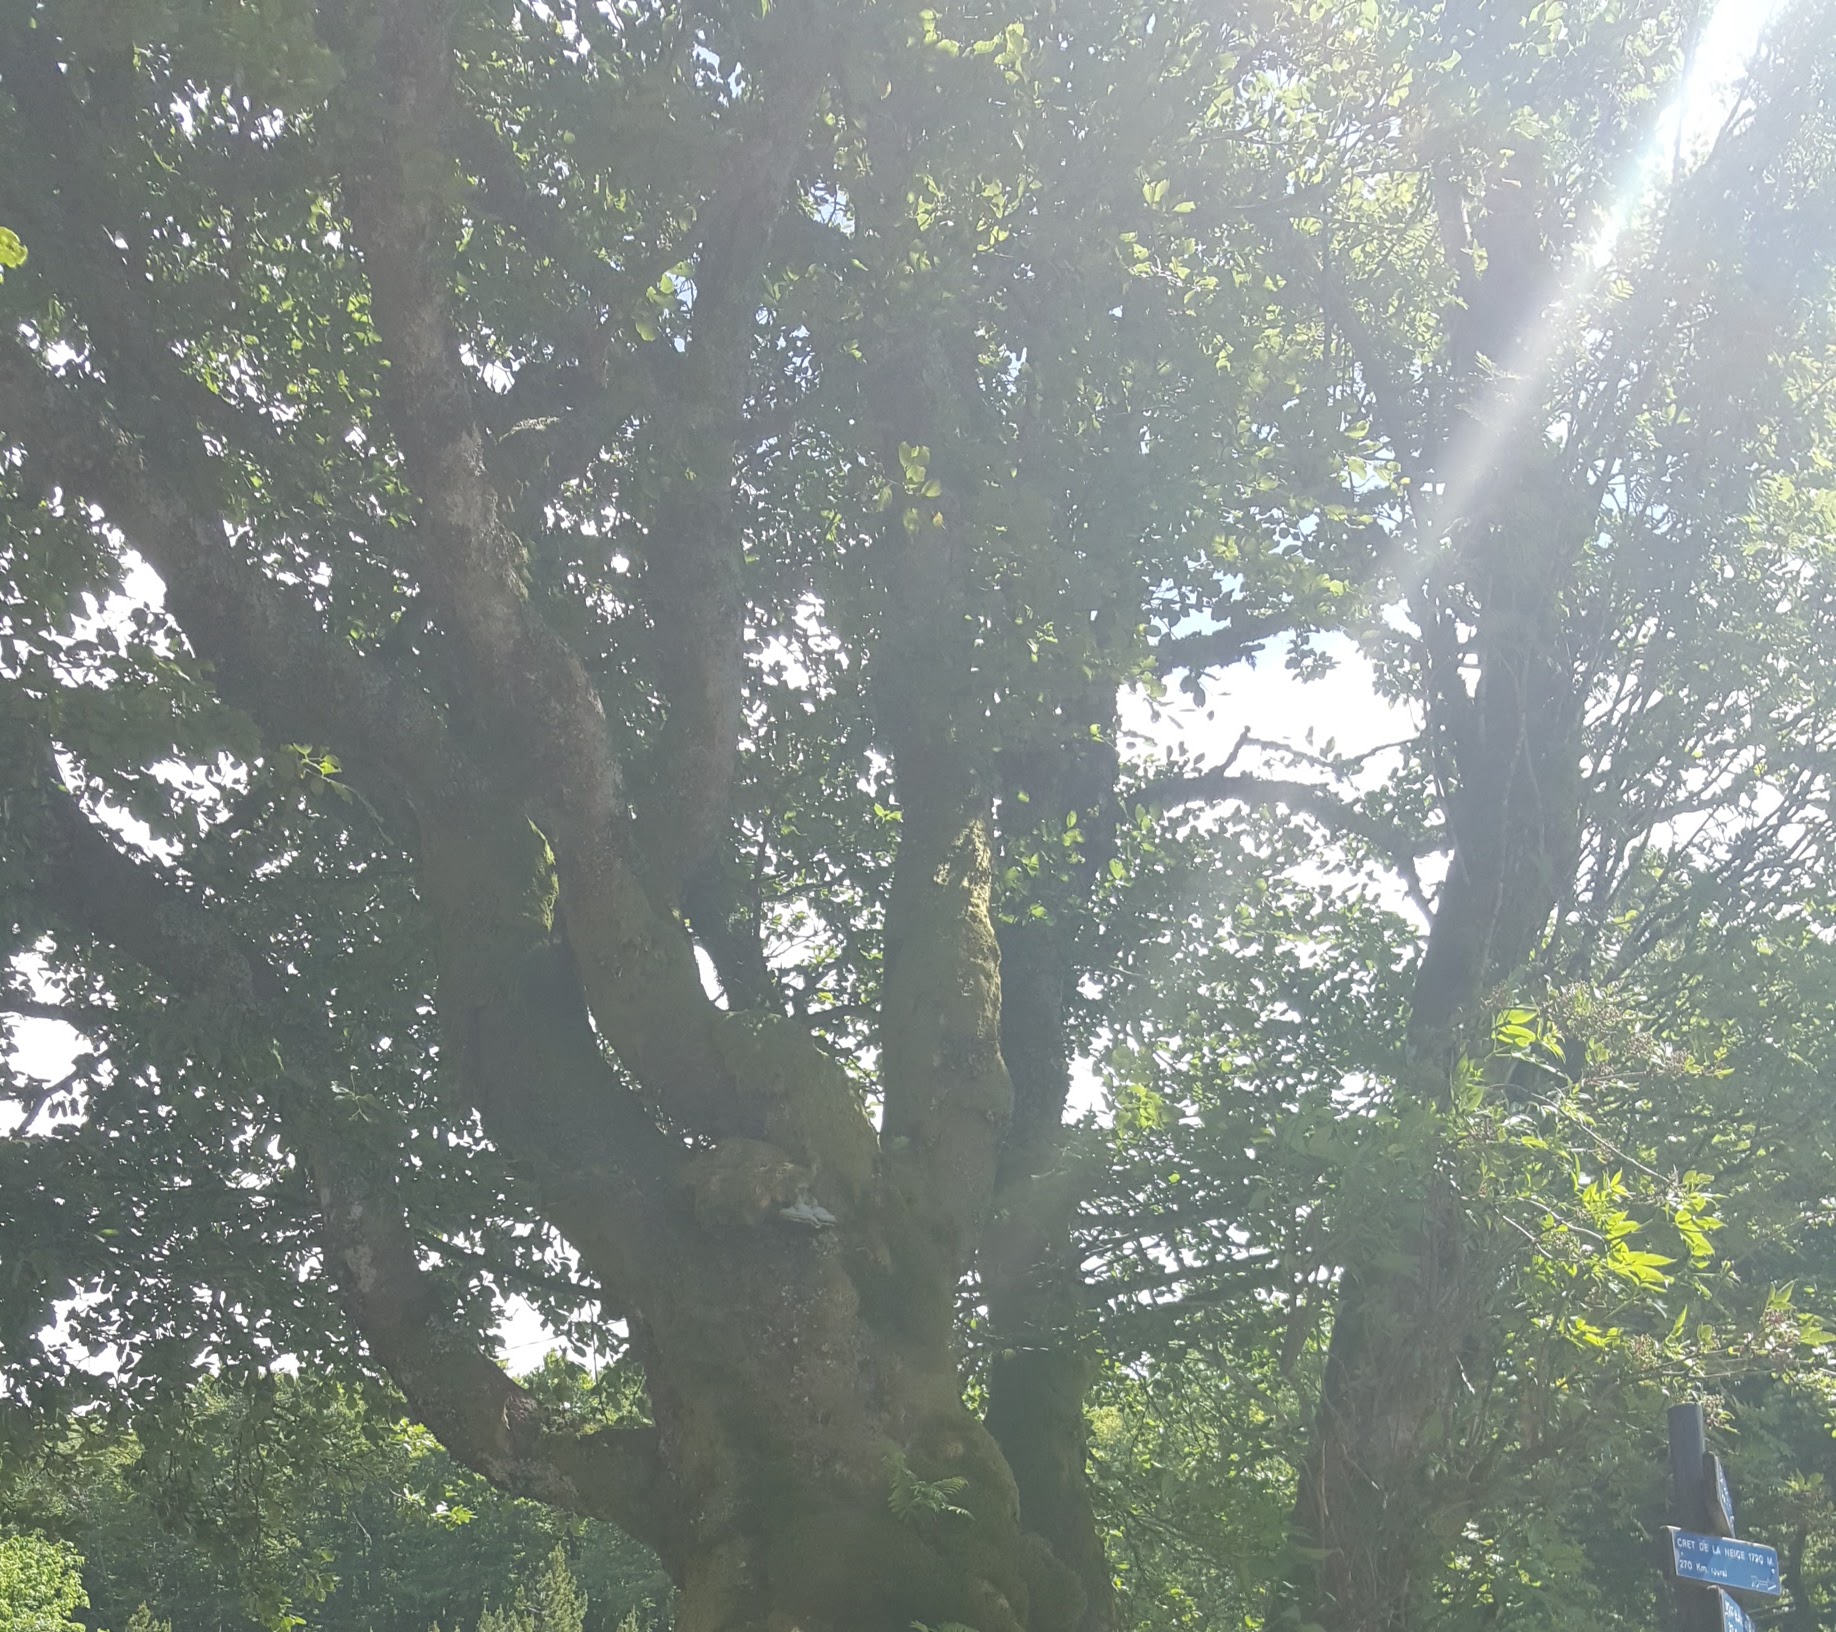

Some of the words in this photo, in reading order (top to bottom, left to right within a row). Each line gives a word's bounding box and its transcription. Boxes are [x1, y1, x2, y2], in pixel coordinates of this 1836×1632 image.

[1677, 1538, 1695, 1550] CRET
[1699, 1543, 1709, 1552] DE
[1712, 1545, 1721, 1555] LA
[1725, 1547, 1745, 1560] NEIGE
[1748, 1552, 1763, 1565] 1720
[1680, 1559, 1693, 1570] 270
